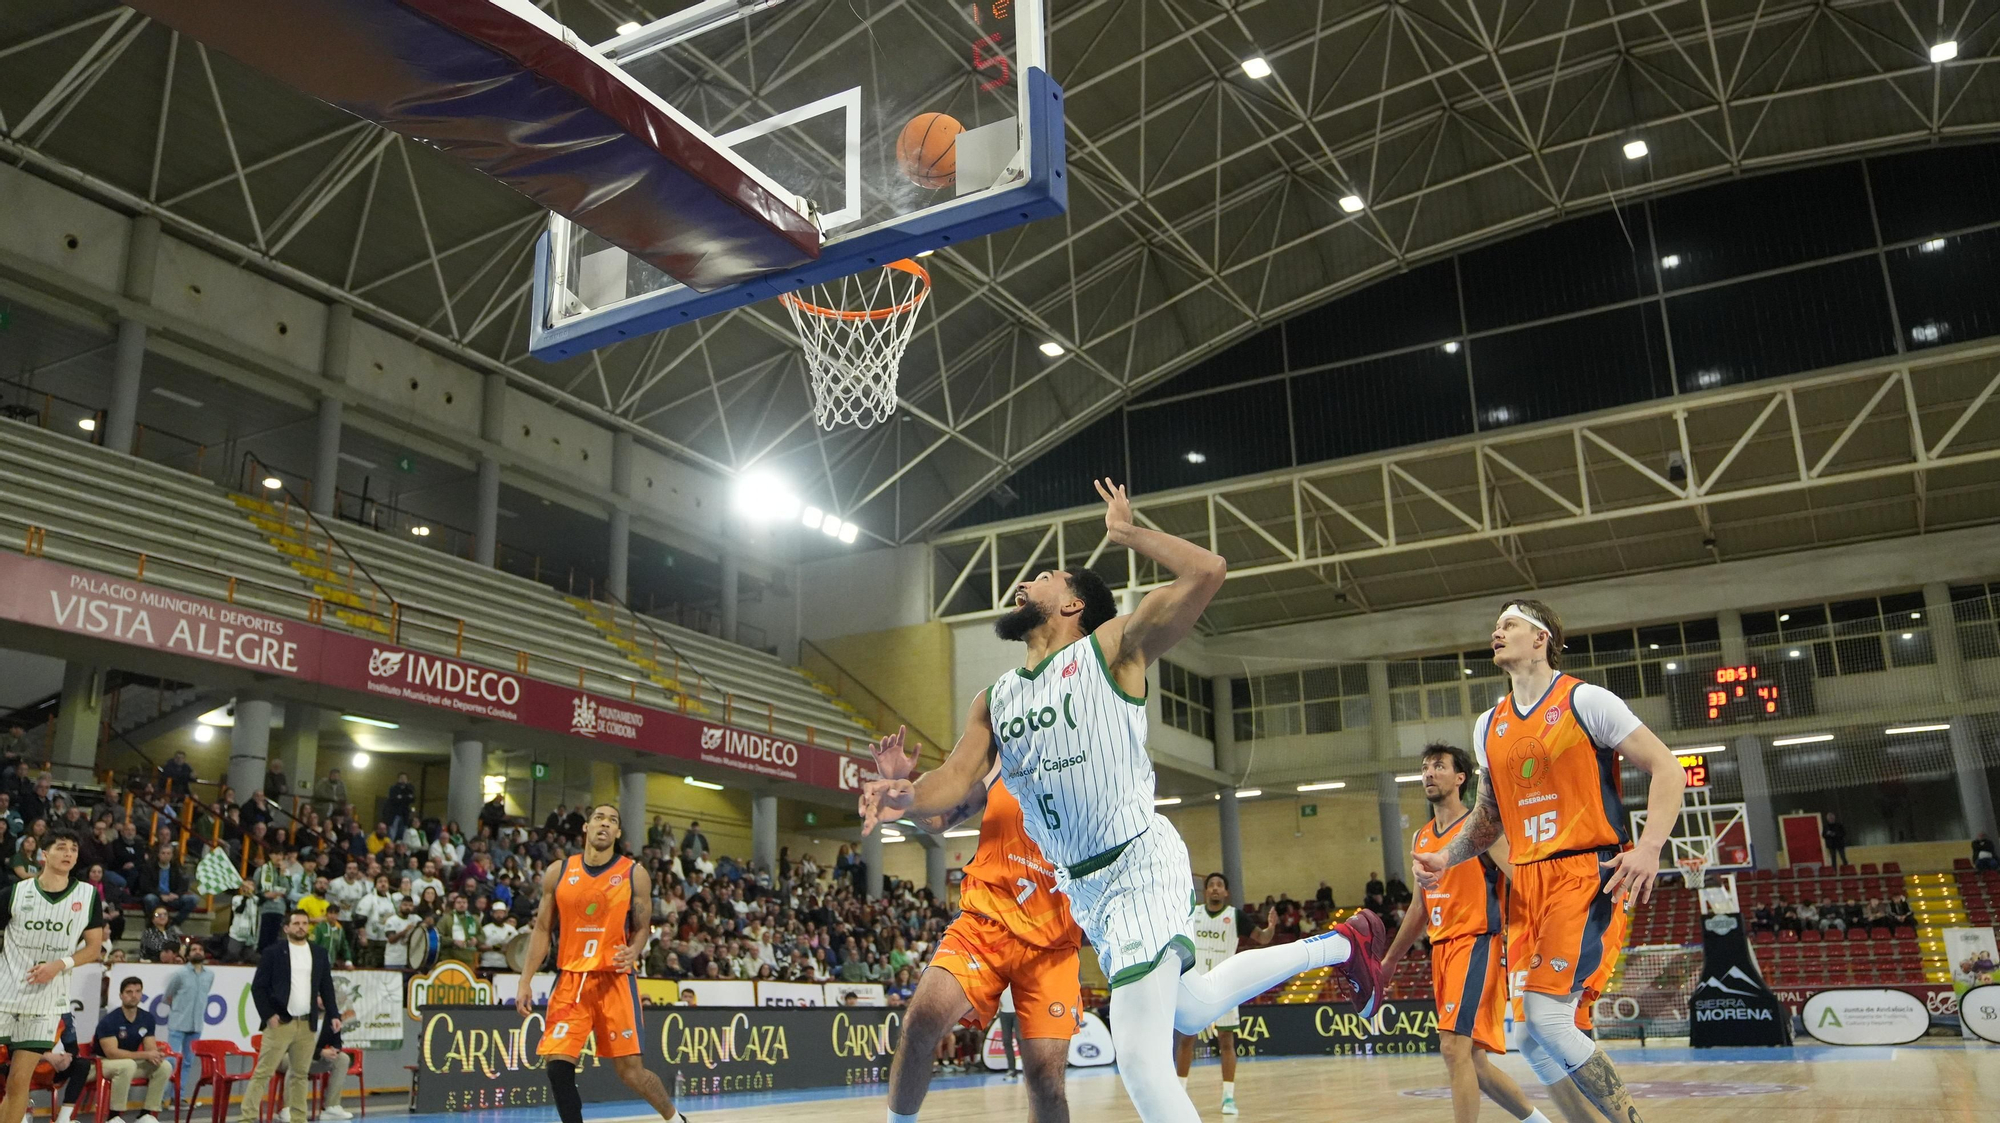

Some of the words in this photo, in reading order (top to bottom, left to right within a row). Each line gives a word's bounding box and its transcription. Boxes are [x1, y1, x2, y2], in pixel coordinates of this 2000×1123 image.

[70, 574, 137, 602] PALACIO
[139, 590, 216, 621] MUNICIPAL
[220, 609, 284, 636] DEPORTES
[49, 589, 156, 644] VISTA
[166, 618, 299, 673] ALEGRE
[406, 653, 520, 705] IMDECO
[367, 680, 401, 696] Instituto
[401, 687, 441, 705] Municipal
[441, 697, 452, 708] de
[452, 698, 486, 714] Deportes
[1758, 686, 1778, 700] 41
[1000, 705, 1057, 744] coto
[724, 729, 798, 767] IMDECO
[535, 764, 544, 777] D
[1042, 750, 1087, 773] Cajasol
[1687, 767, 1705, 786] 12
[1035, 793, 1061, 830] 15
[1523, 810, 1558, 844] 45
[1016, 877, 1038, 905] 7
[24, 919, 64, 932] coto
[1430, 906, 1442, 927] 6
[1196, 930, 1220, 939] coto
[583, 939, 599, 958] 0
[1205, 958, 1212, 971] 4
[1695, 998, 1746, 1010] SIERRA
[1696, 1008, 1773, 1022] MORENA
[552, 1022, 570, 1039] 0
[1333, 1040, 1428, 1056] SELECCIÓN
[445, 1085, 547, 1112] SELECCI
